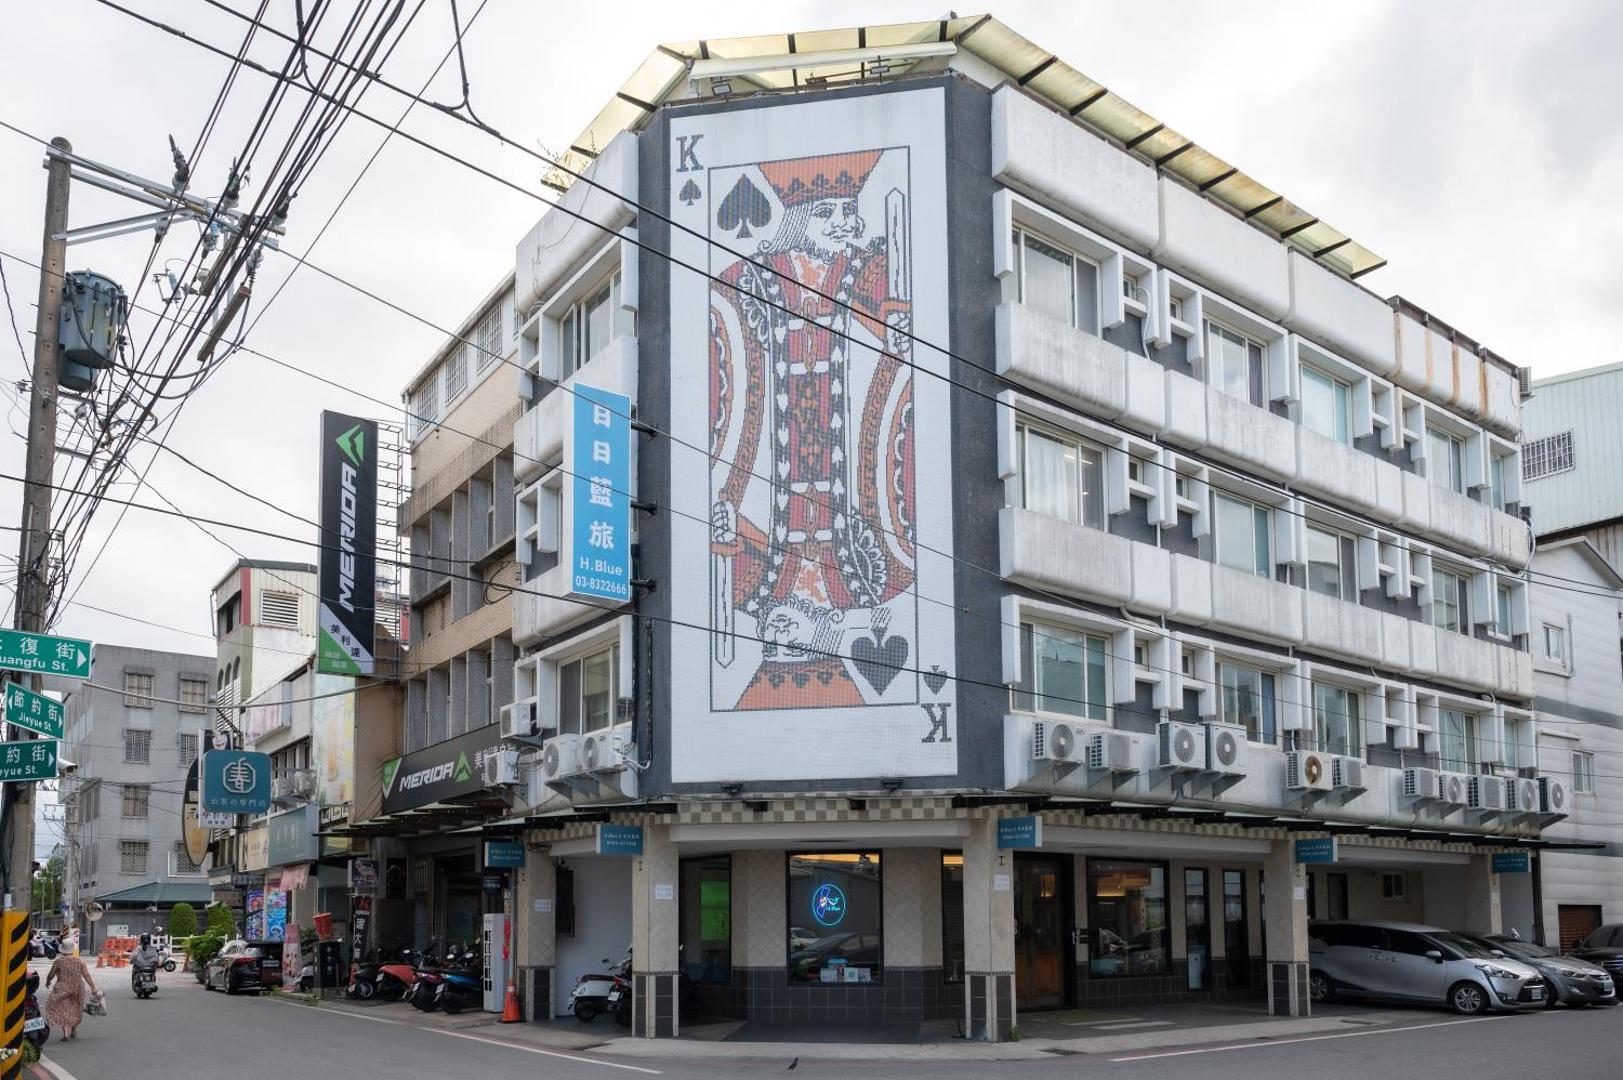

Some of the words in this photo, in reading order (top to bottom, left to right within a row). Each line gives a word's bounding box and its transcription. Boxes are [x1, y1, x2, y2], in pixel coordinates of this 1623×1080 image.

[676, 134, 704, 173] K
[588, 404, 614, 550] 日日藍旅
[339, 462, 357, 612] MERIDA
[579, 556, 623, 576] H.Blue
[575, 575, 626, 595] 03-8322666
[52, 660, 69, 672] St.
[14, 690, 58, 722] 節約街
[18, 712, 43, 728] Jieyue
[43, 721, 53, 732] St.
[921, 703, 952, 743] K
[25, 765, 38, 775] St.
[399, 761, 455, 793] MERIDA
